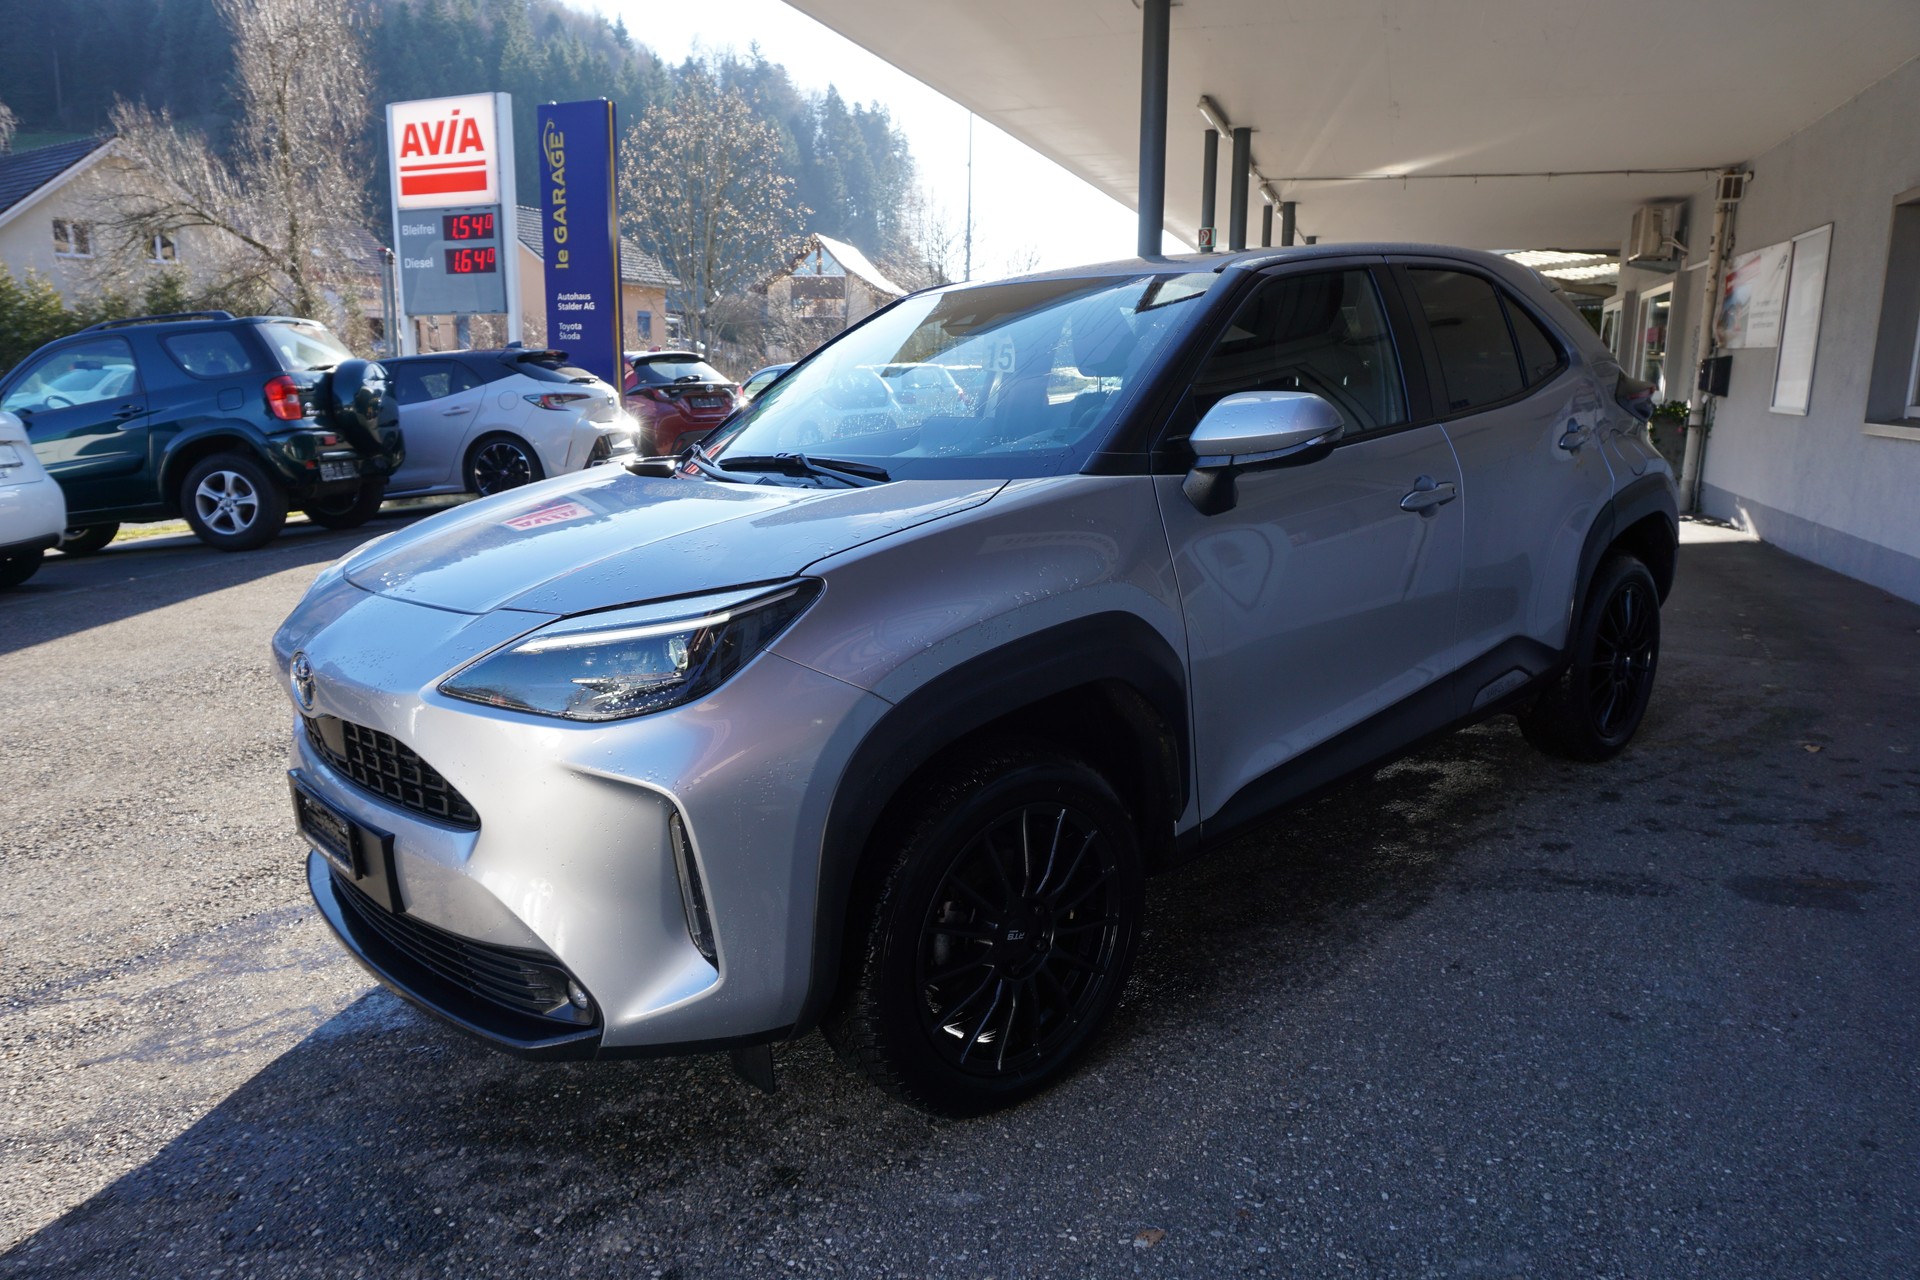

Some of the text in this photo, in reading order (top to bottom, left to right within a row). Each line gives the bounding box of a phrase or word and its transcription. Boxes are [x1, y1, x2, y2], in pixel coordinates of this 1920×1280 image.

[550, 131, 569, 269] le GARAGE
[402, 223, 436, 236] Bleifrei
[404, 256, 434, 269] Diesel
[557, 292, 591, 301] Autohaus
[557, 301, 596, 311] Stalder AG
[558, 322, 582, 332] Toyota
